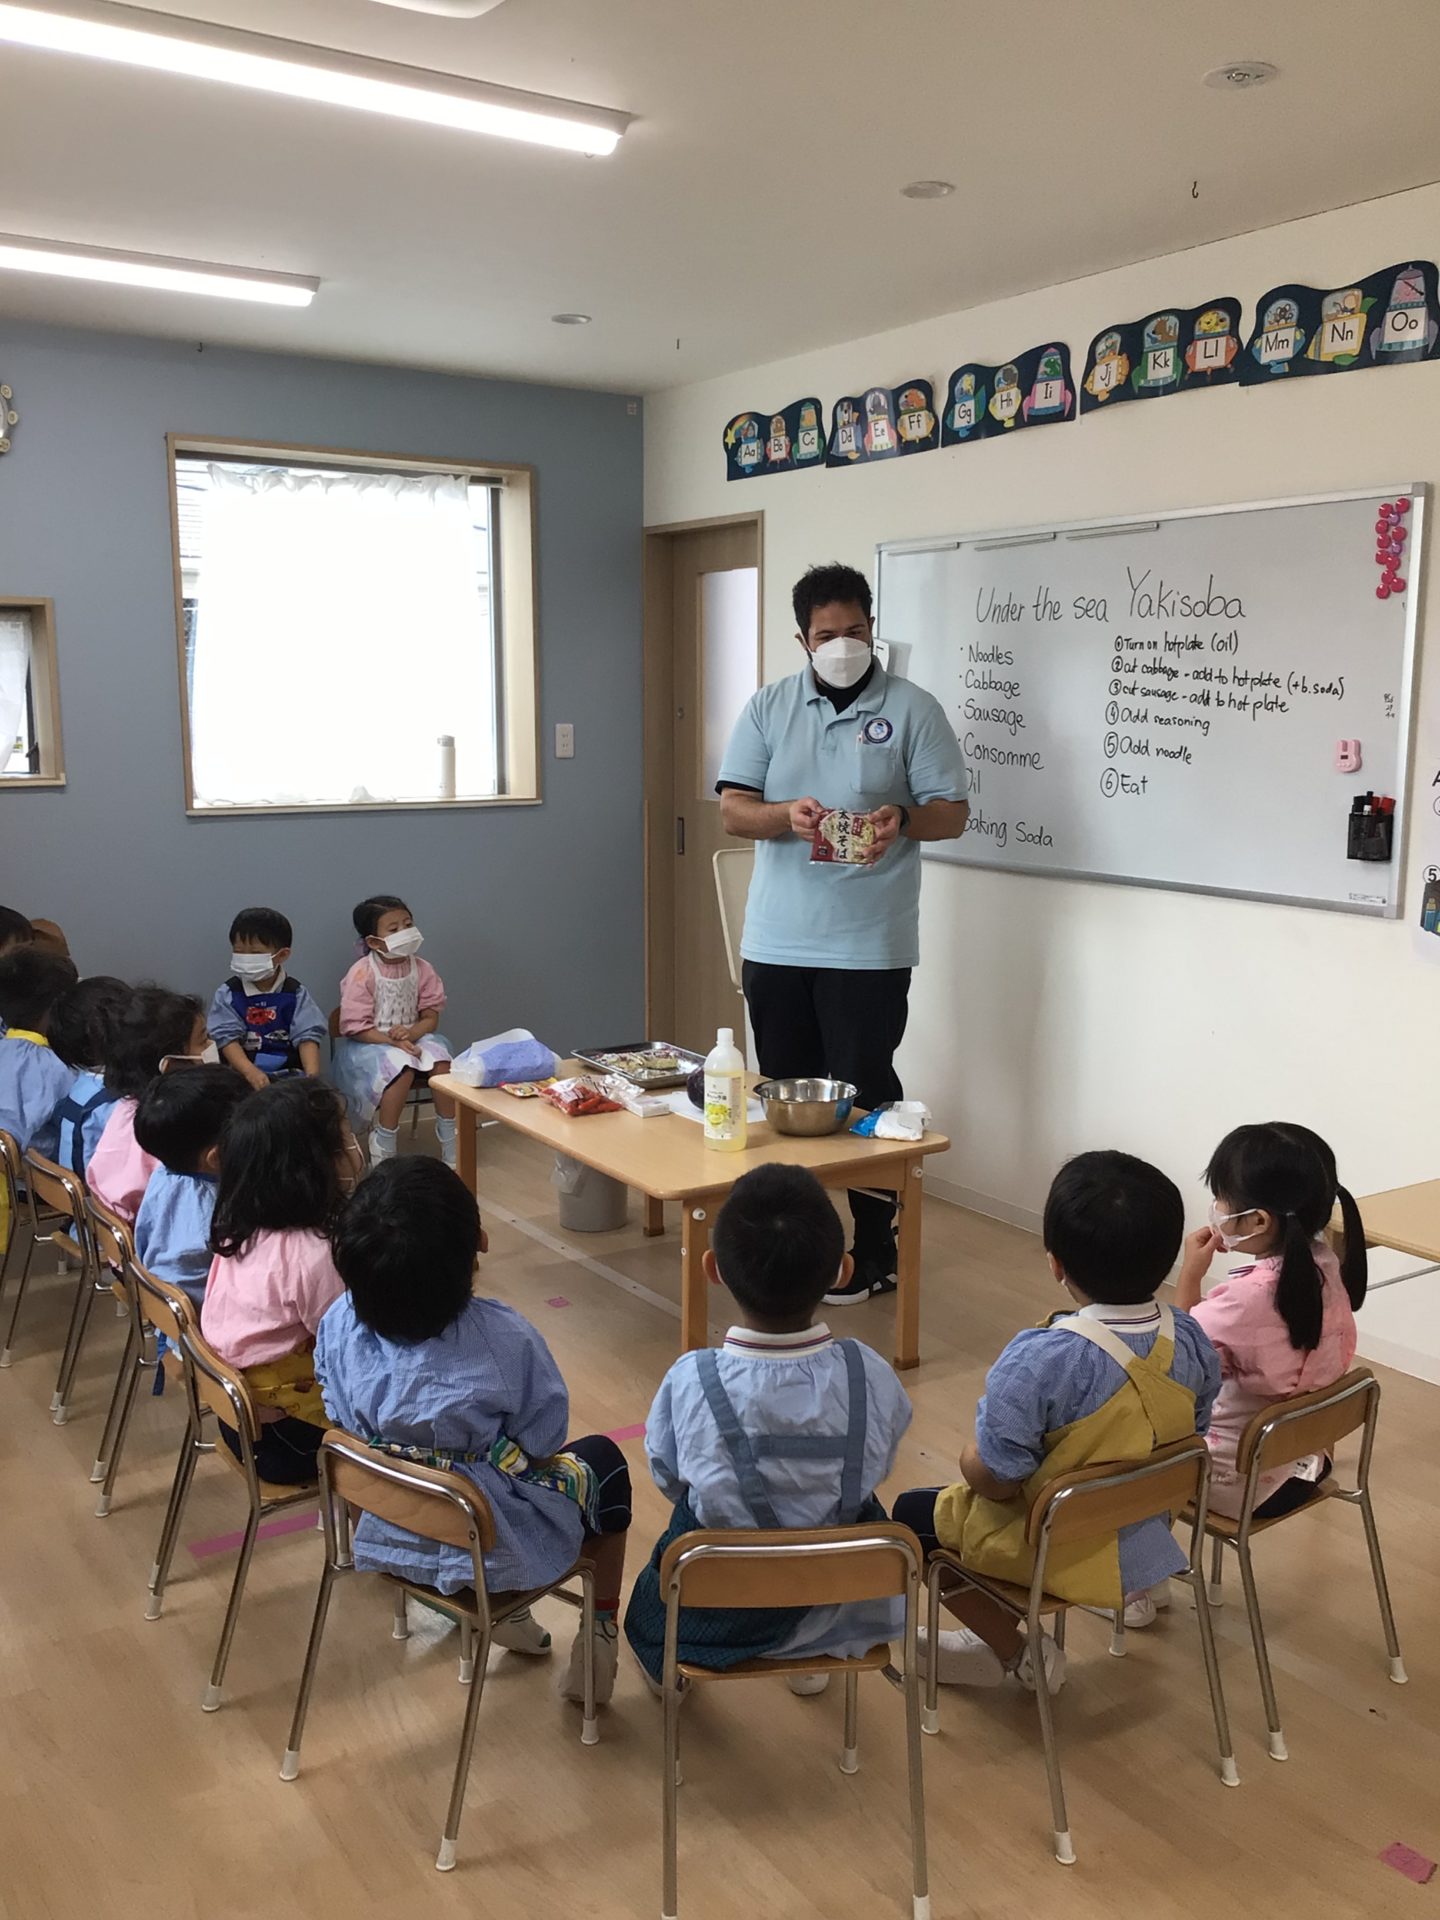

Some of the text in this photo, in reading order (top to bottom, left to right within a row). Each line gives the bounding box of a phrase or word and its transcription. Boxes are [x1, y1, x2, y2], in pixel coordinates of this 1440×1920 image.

[1391, 311, 1419, 332] Oo
[1264, 332, 1290, 353] Mm
[1330, 322, 1354, 343] Nn
[1203, 339, 1219, 359] Ll
[1152, 351, 1170, 371] Kk
[1100, 363, 1113, 388] Jj
[1000, 391, 1014, 410] Hh
[1043, 382, 1053, 400] Ii
[908, 413, 922, 431] Ff
[958, 403, 972, 424] Gg
[802, 432, 815, 446] Cc
[841, 429, 853, 444] Dd
[873, 422, 885, 438] Ee
[743, 445, 756, 458] Aa
[976, 566, 1246, 624] Under the sea Yakisoba
[968, 640, 1014, 666] Noodles
[1124, 637, 1145, 651] Turn
[1147, 640, 1158, 650] on
[1163, 630, 1205, 659] hotplate
[1211, 629, 1239, 656] (oil)
[1141, 656, 1180, 682] cabbage
[1192, 666, 1213, 683] add
[1214, 668, 1229, 685] to
[965, 668, 1021, 700] Cabbage
[1122, 680, 1139, 696] cut
[1140, 686, 1179, 703] sausage
[1189, 688, 1211, 707] add
[1215, 690, 1226, 708] to
[963, 697, 1026, 737] Sausage
[963, 731, 1045, 771] Consomme
[1155, 744, 1192, 765] noodle
[1120, 773, 1148, 795] Eat
[1015, 820, 1054, 848] Soda
